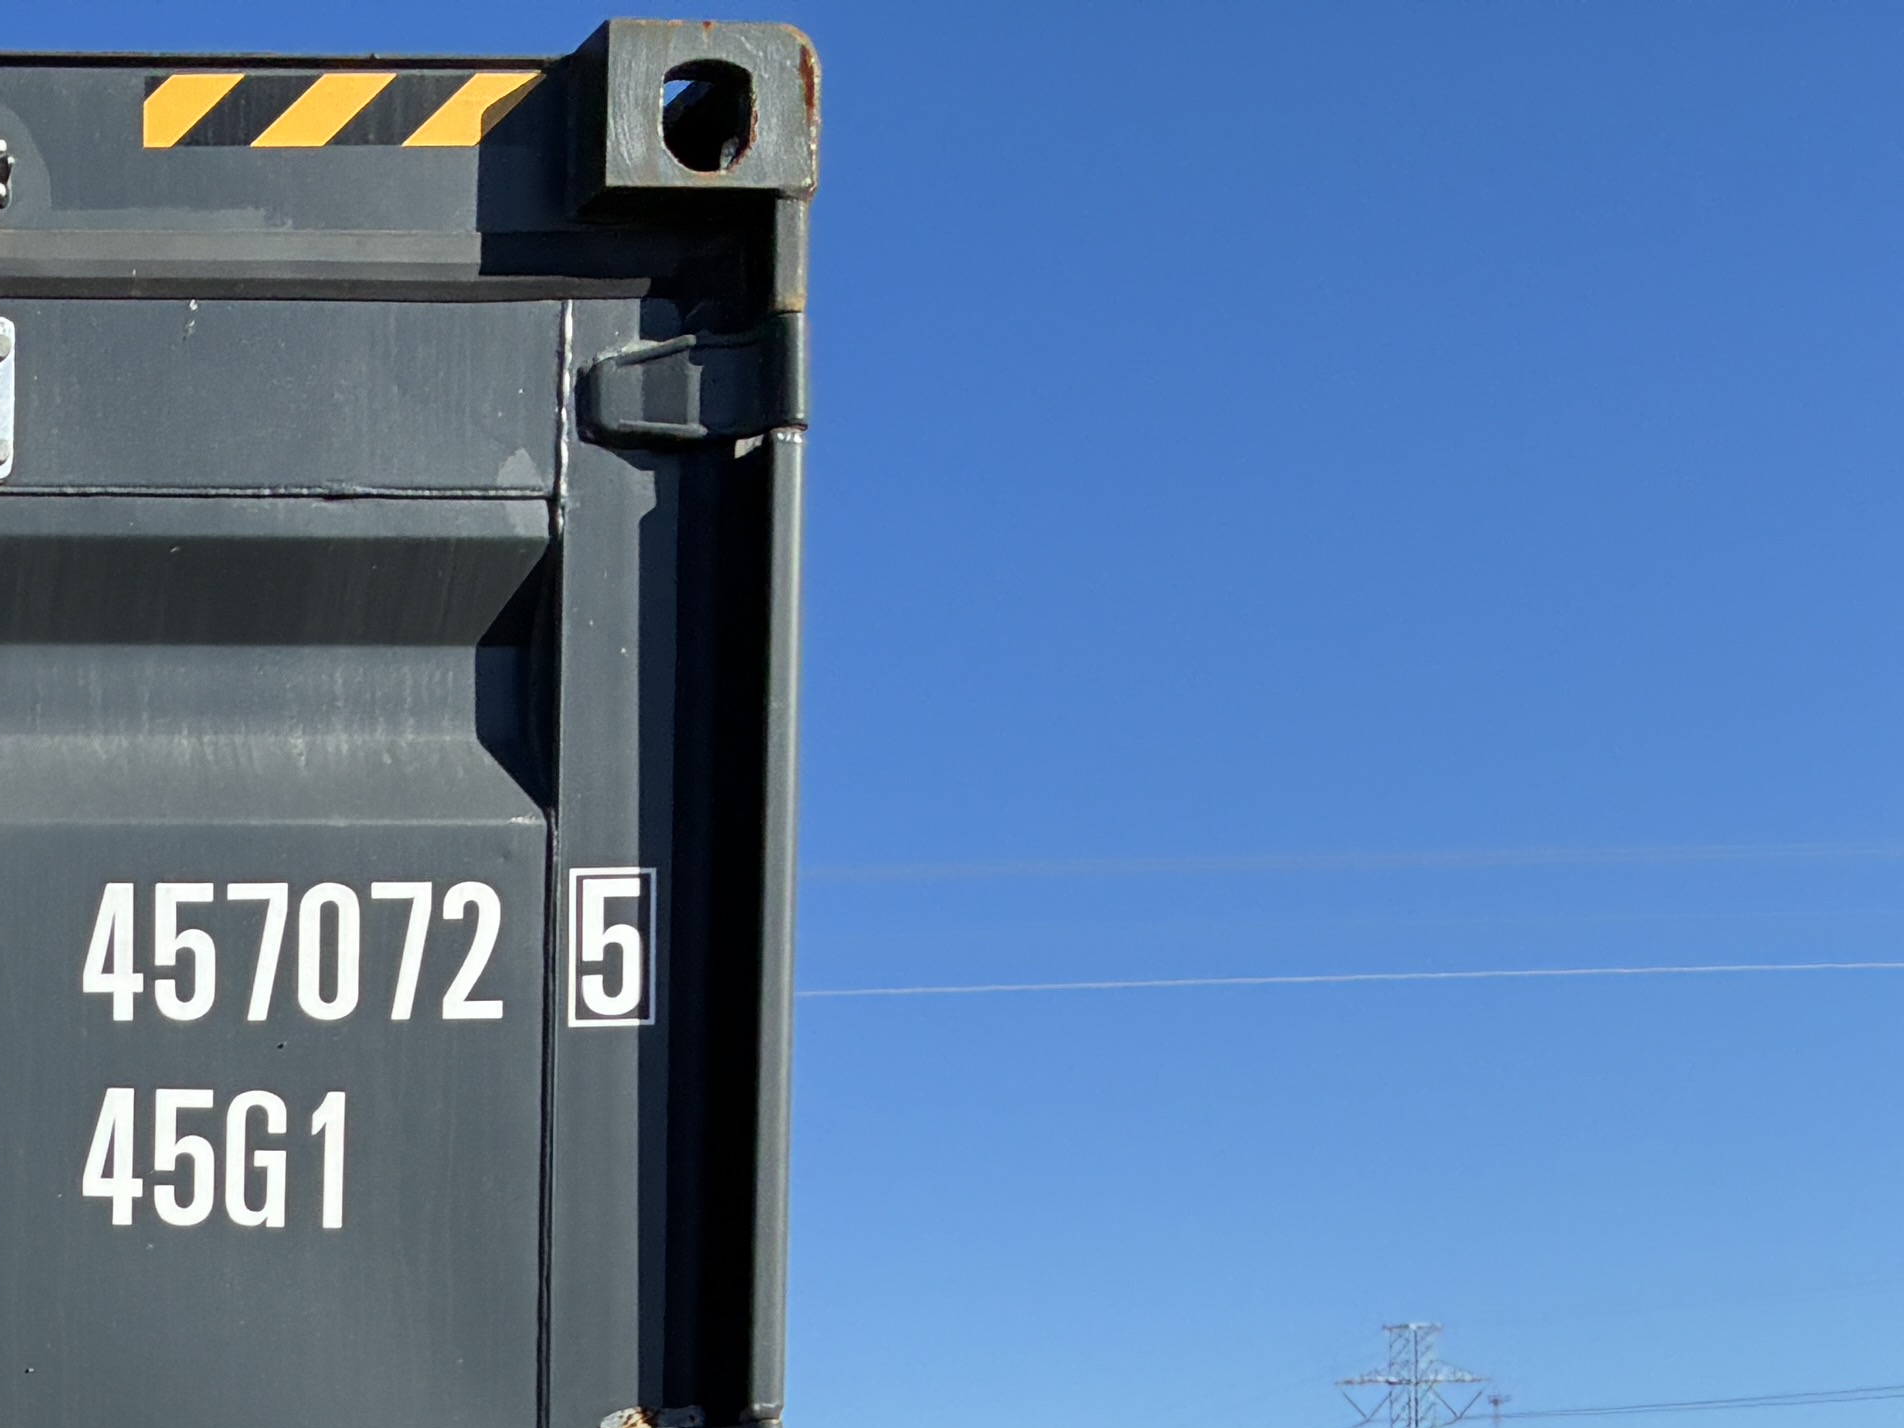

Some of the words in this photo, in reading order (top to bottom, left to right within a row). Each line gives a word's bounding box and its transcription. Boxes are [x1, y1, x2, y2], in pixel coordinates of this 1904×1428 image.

[82, 880, 504, 1022] 457072
[581, 877, 641, 1016] 5
[82, 1087, 346, 1230] 45G1
